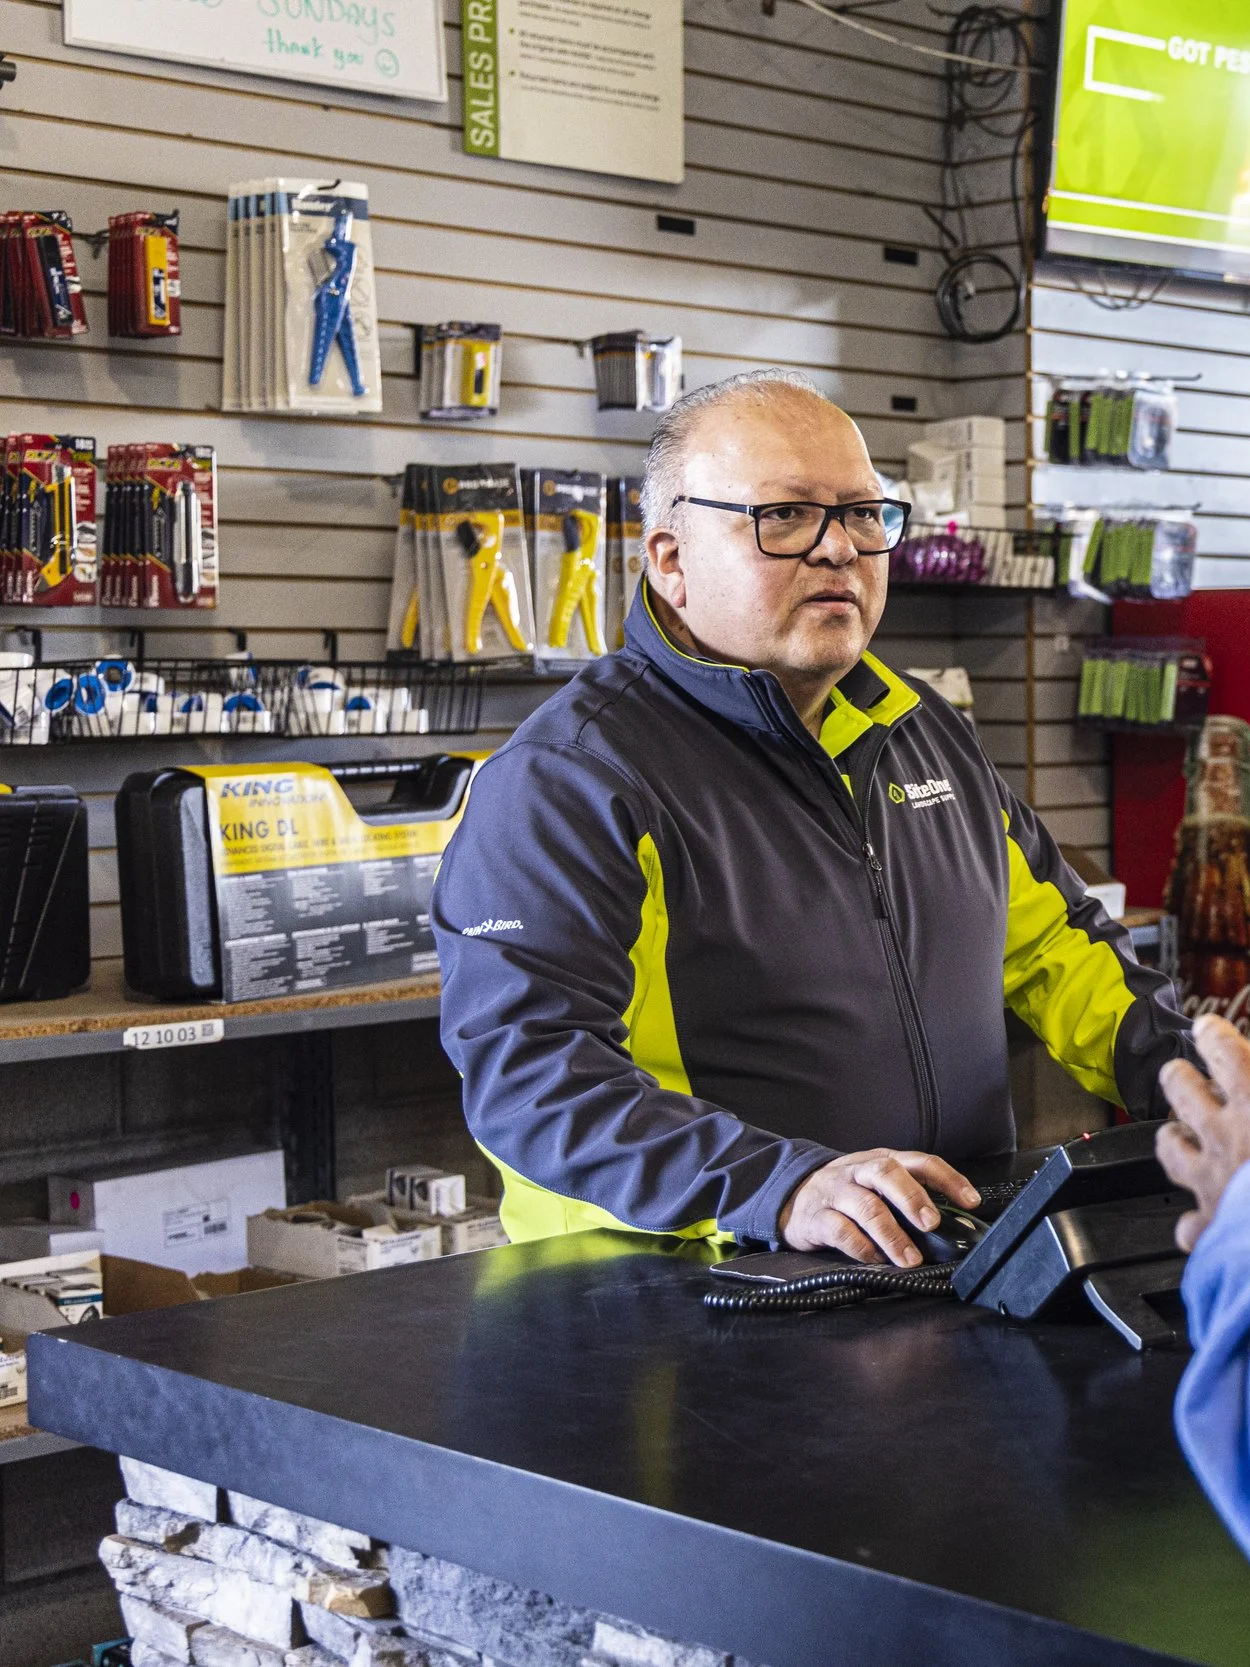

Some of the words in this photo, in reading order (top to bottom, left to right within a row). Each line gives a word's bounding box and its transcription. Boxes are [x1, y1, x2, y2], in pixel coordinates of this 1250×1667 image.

[467, 0, 493, 44] PR
[333, 48, 366, 69] you
[1168, 35, 1212, 66] GOT
[469, 51, 495, 148] SALES
[220, 778, 295, 799] KING
[221, 820, 270, 842] KING
[277, 818, 299, 836] DL
[133, 1032, 150, 1046] 12
[157, 1028, 174, 1045] 10
[177, 1026, 197, 1042] 03
